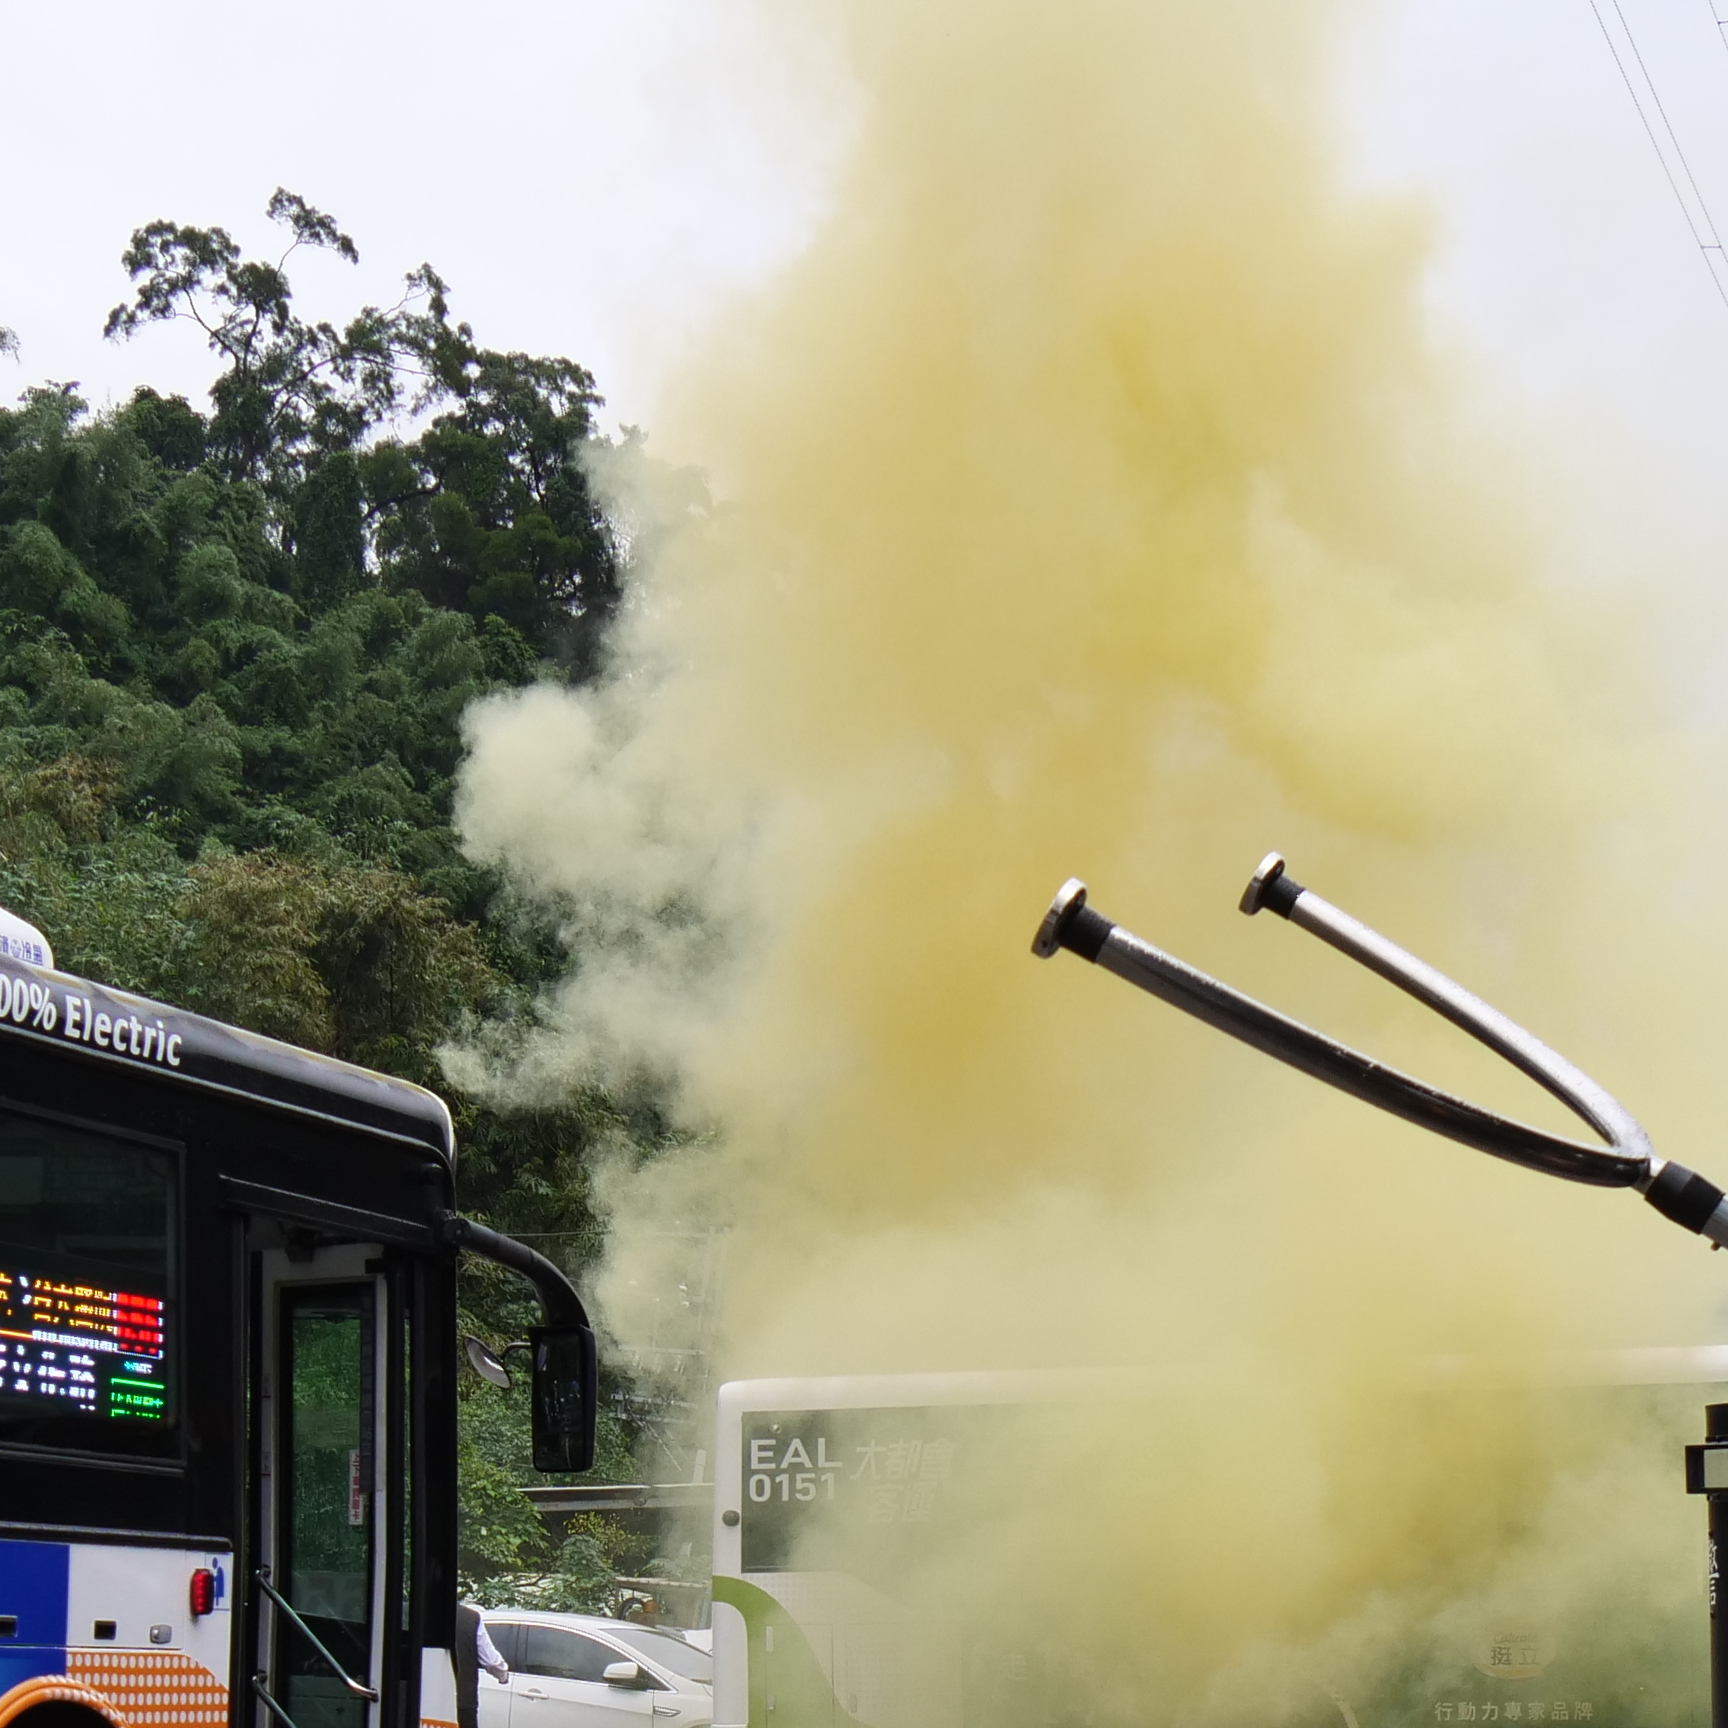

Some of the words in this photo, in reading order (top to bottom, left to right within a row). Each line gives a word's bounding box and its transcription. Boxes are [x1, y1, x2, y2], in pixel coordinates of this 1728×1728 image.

[64, 994, 183, 1067] Electric
[750, 1438, 842, 1470] EAL
[749, 1473, 836, 1502] 0151
[1490, 1646, 1541, 1666] 挺立
[1434, 1700, 1595, 1723] 行動力專家品牌
